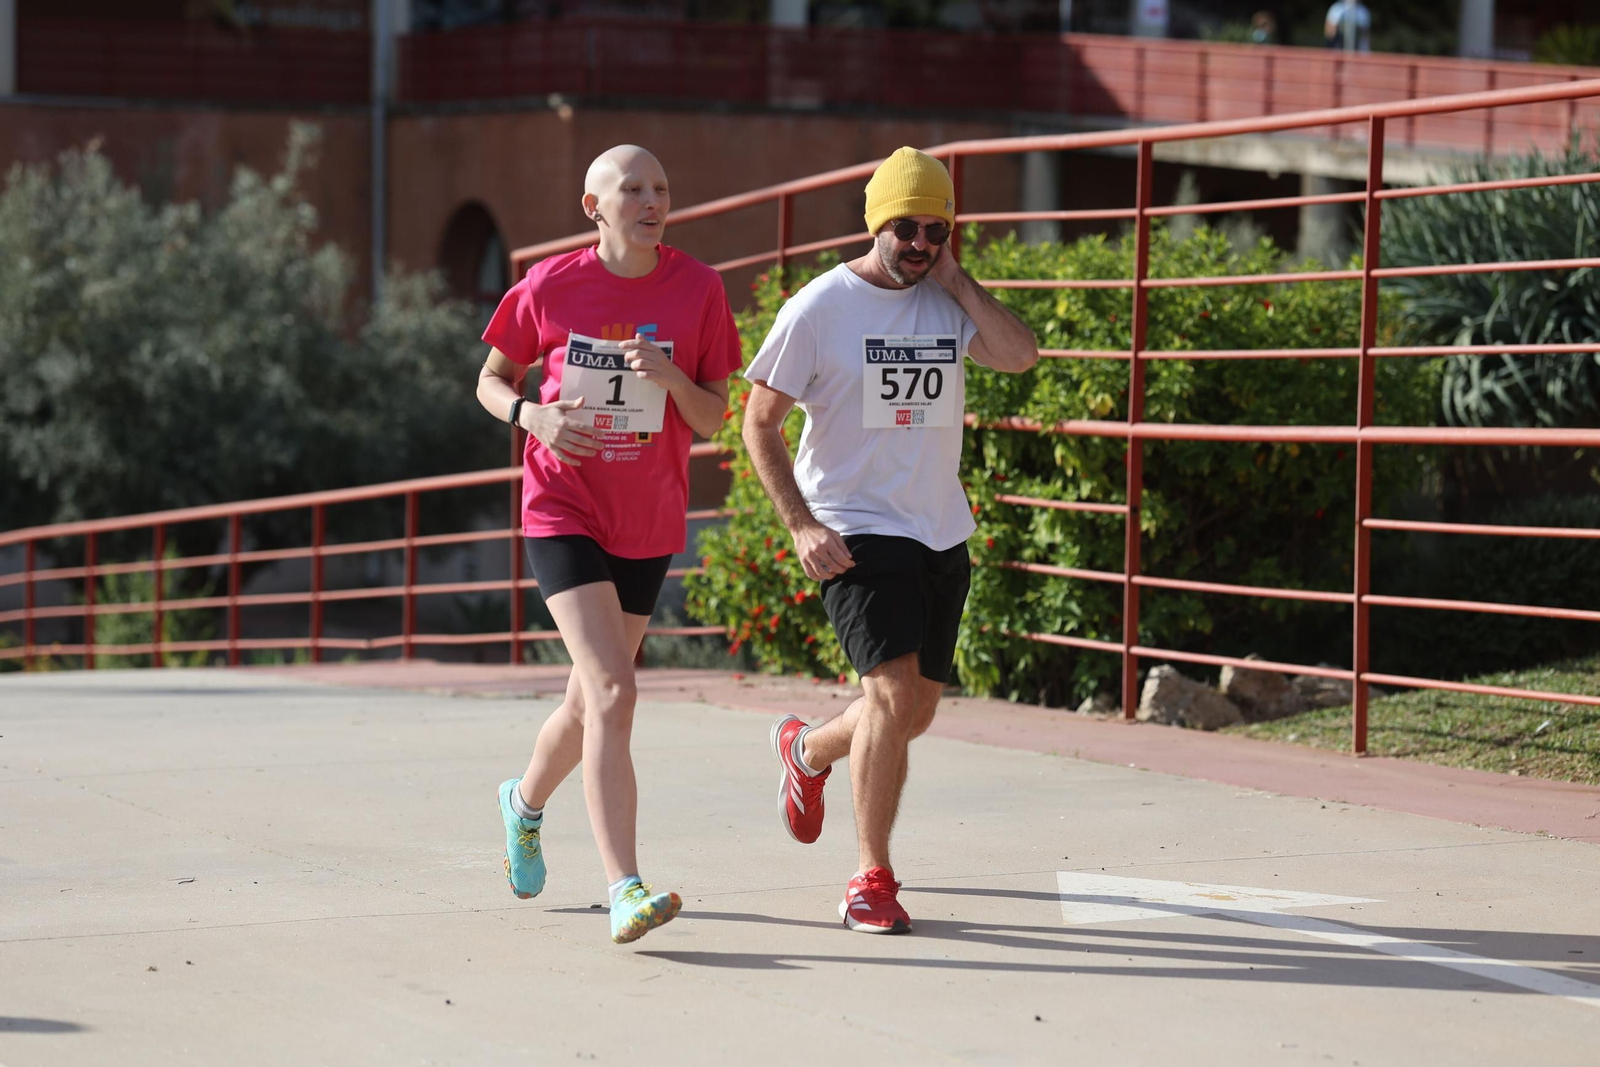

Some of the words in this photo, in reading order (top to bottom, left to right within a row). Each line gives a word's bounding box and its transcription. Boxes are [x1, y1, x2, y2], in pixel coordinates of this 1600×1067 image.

[571, 350, 617, 368] UMA
[868, 349, 910, 361] UMA
[605, 374, 626, 406] 1
[881, 367, 943, 400] 570
[596, 417, 613, 426] WE
[896, 413, 911, 422] WE
